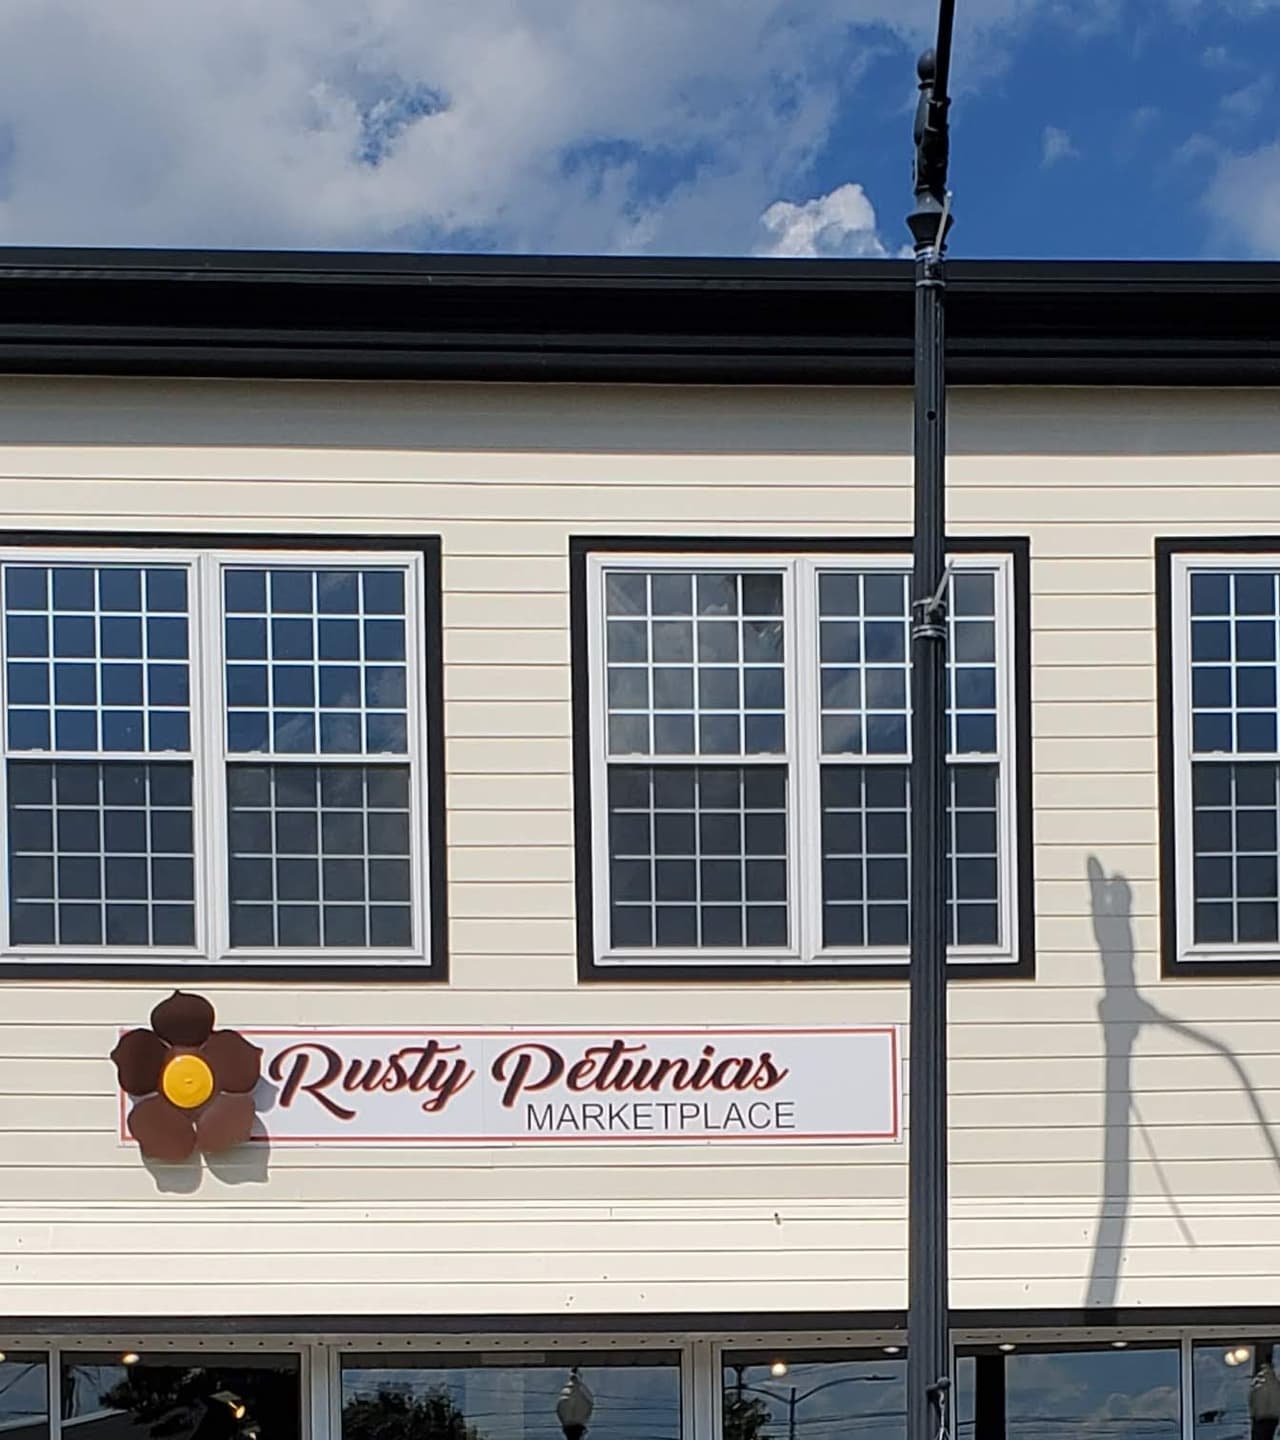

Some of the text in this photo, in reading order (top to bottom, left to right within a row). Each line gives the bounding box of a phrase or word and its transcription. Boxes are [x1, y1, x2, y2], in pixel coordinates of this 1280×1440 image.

[269, 1038, 789, 1120] Rusty Petunias
[526, 1101, 795, 1131] MARKETPLACE
